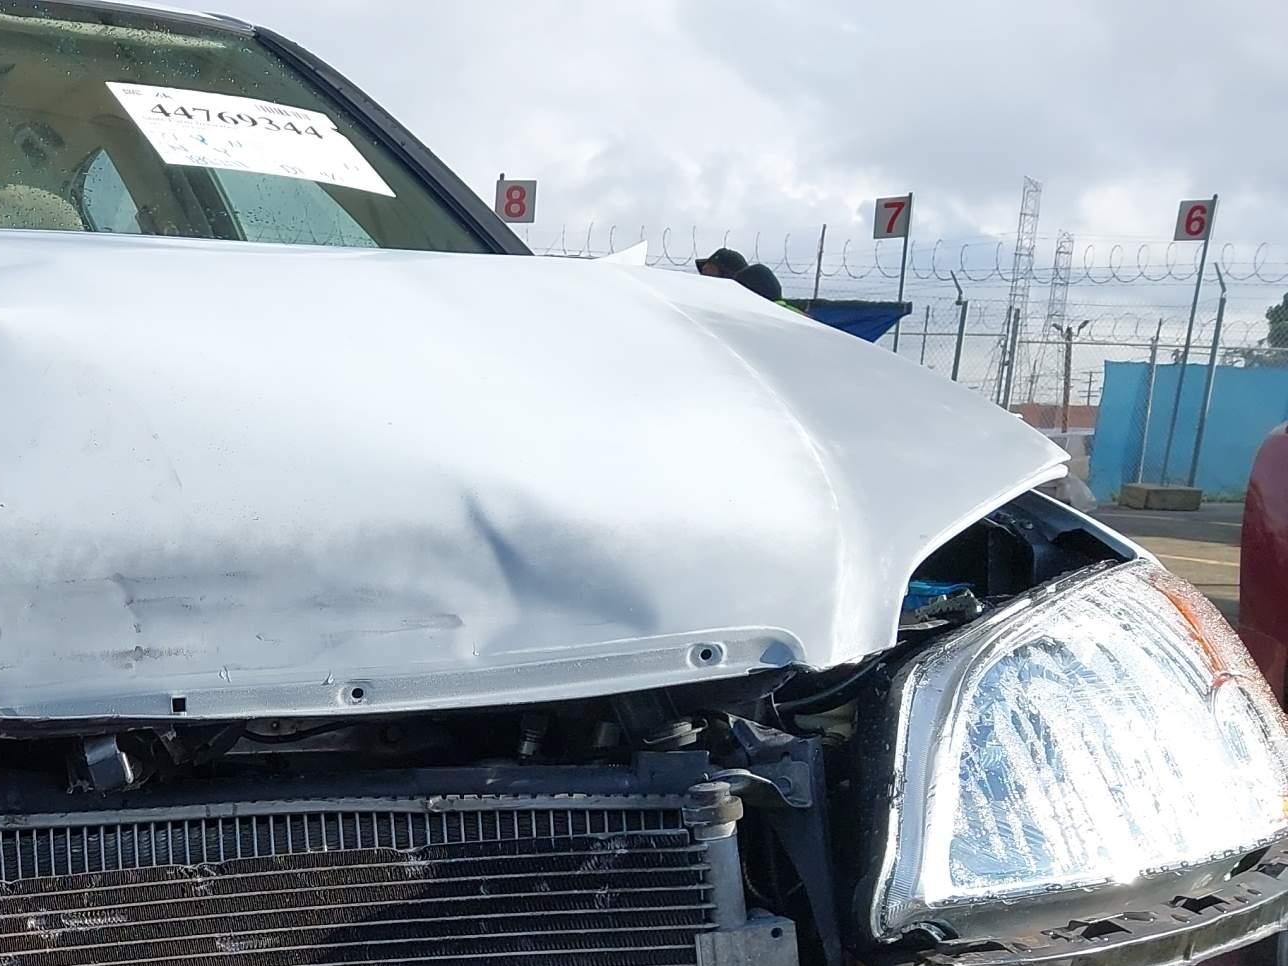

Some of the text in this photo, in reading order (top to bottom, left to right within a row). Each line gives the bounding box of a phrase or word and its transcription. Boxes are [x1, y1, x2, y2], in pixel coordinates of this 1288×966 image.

[151, 103, 324, 139] 44769344
[504, 184, 526, 218] 8
[883, 201, 905, 234] 7
[1184, 204, 1208, 237] 6
